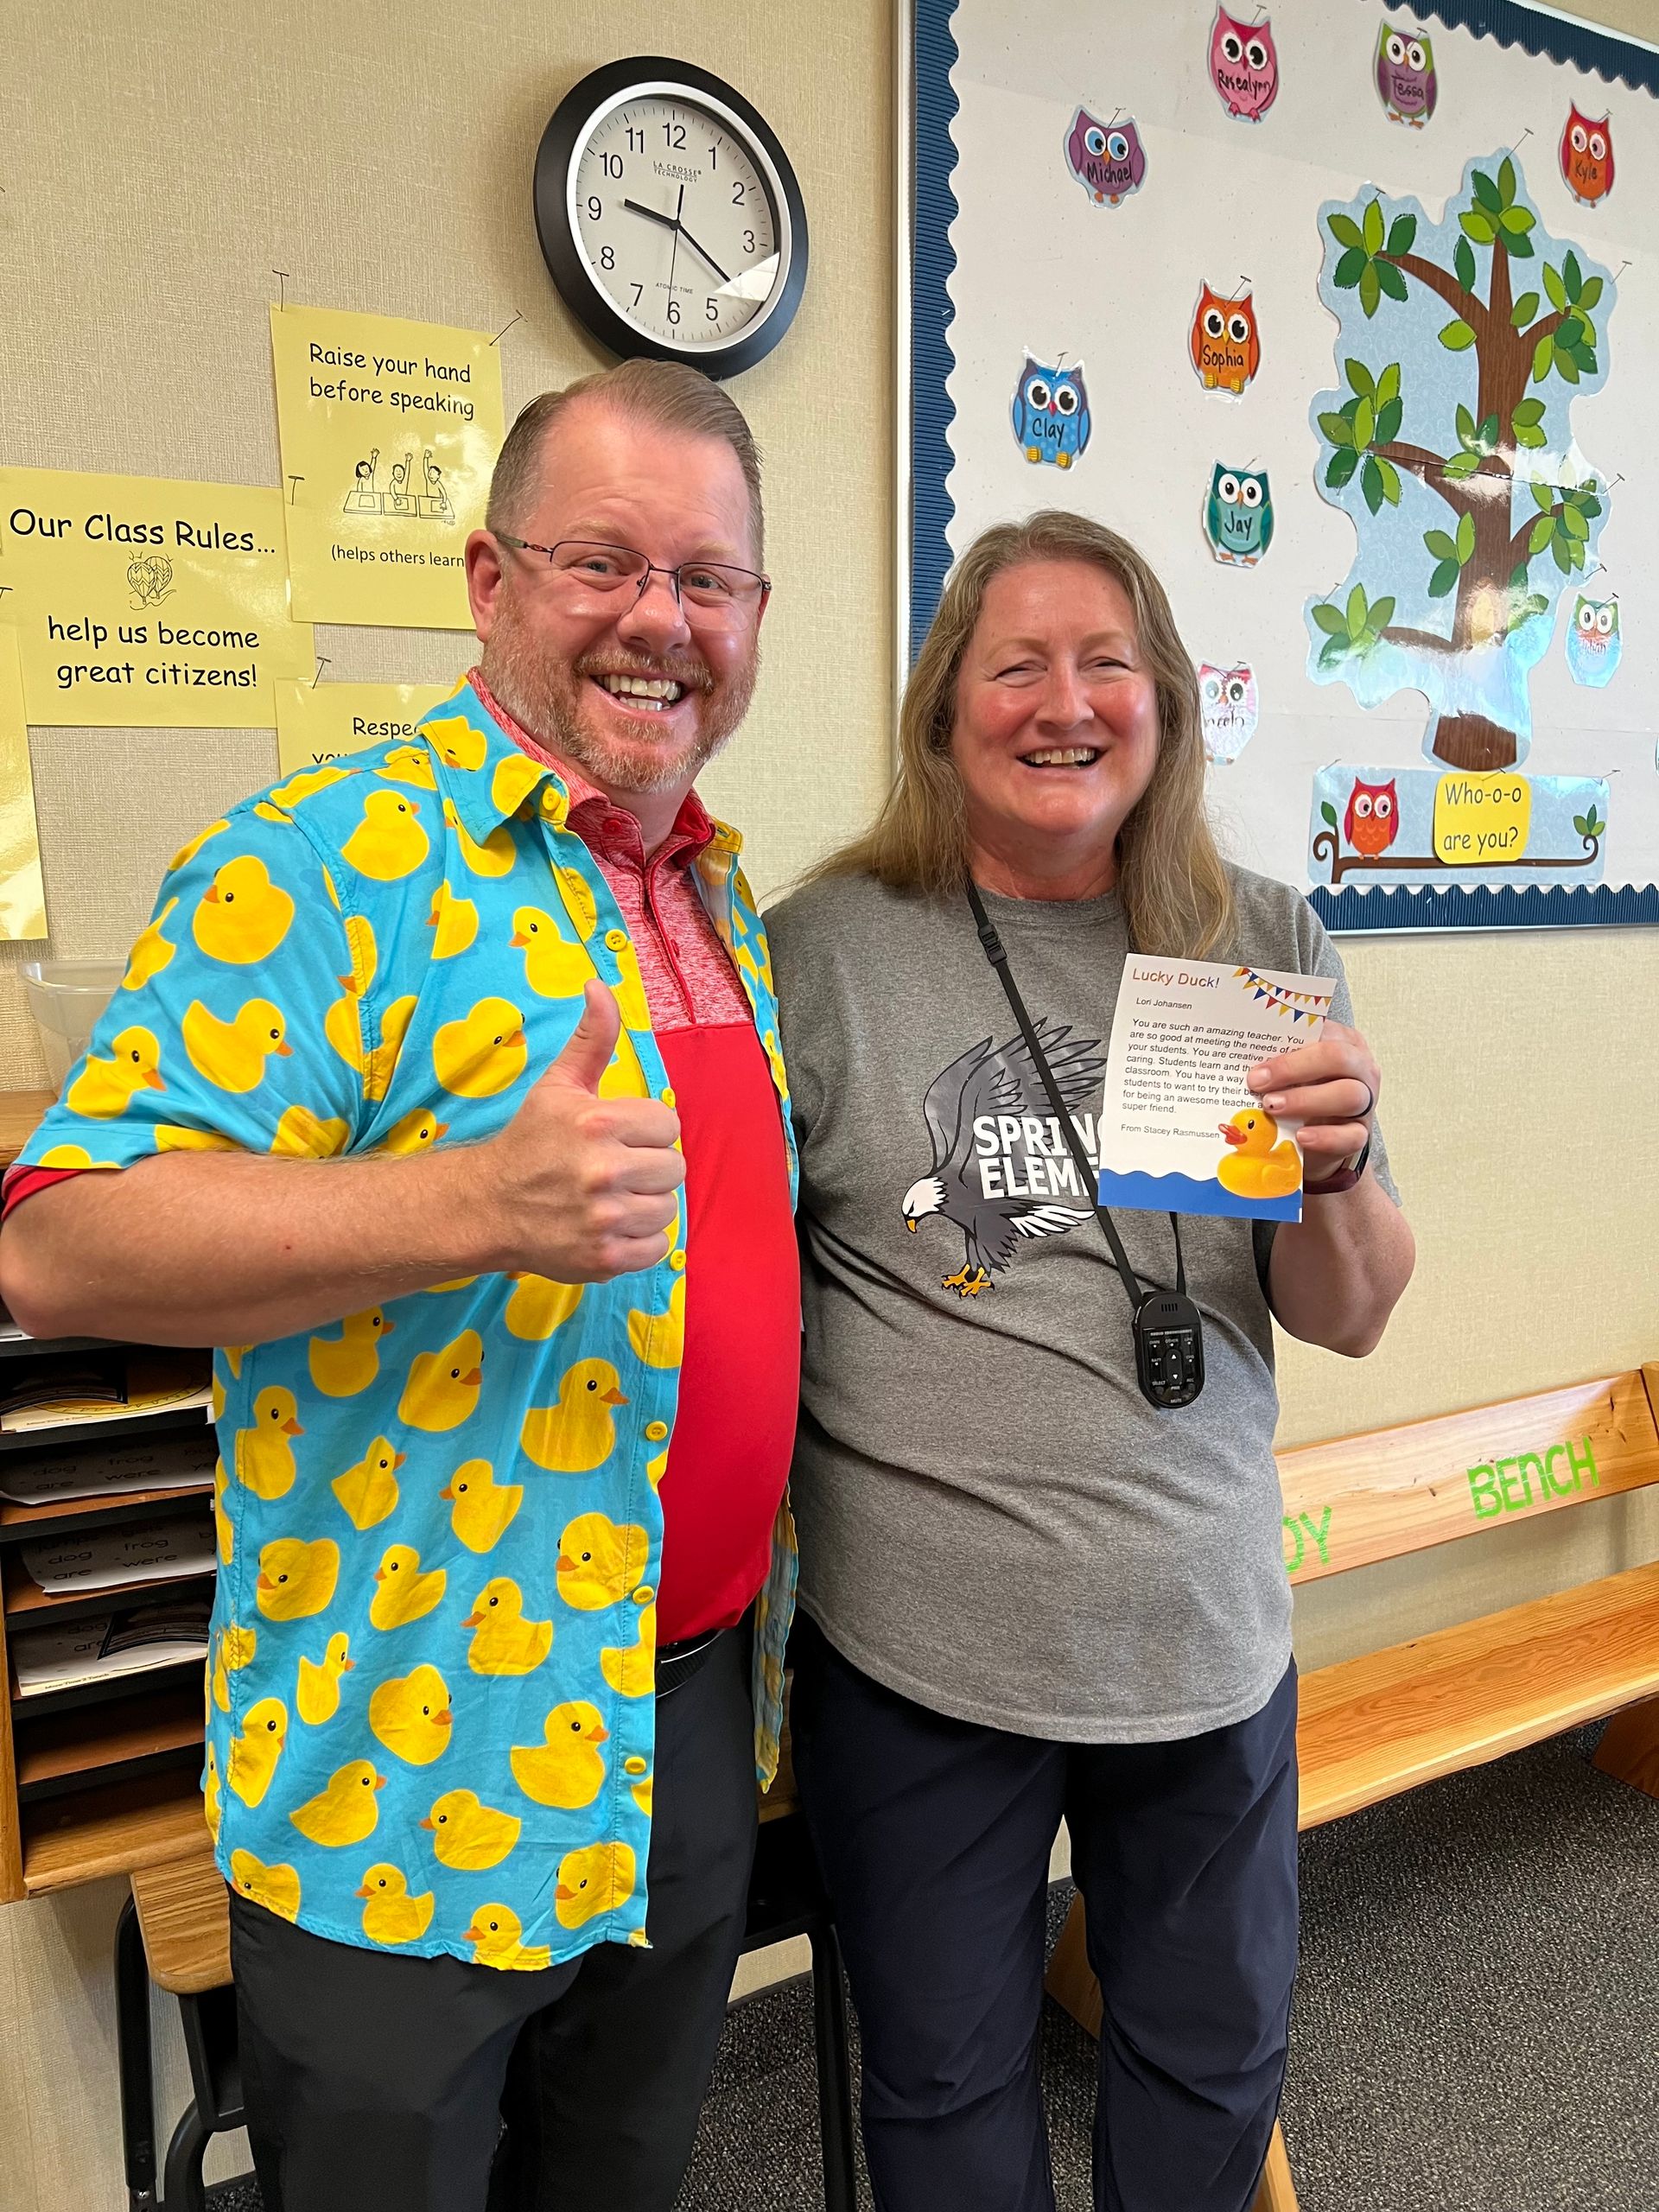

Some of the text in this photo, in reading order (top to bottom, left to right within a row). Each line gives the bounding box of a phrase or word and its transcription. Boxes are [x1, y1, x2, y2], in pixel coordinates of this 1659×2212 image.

[1391, 75, 1424, 102] Tessa
[626, 126, 645, 154] 11
[662, 122, 686, 149] 12
[600, 152, 623, 179] 10
[709, 146, 717, 170] 1
[654, 168, 696, 182] TECHNOLOGY
[1086, 159, 1133, 185] Michael
[1574, 159, 1599, 182] Kyle
[733, 181, 745, 206] 2
[588, 196, 601, 220] 9
[743, 230, 755, 253] 3
[601, 245, 615, 270] 8
[630, 283, 644, 307] 7
[668, 302, 681, 324] 6
[706, 297, 718, 321] 5
[309, 343, 471, 384] Raise your hand
[1202, 343, 1245, 370] Sophia
[309, 377, 474, 422] before speaking
[1033, 417, 1065, 448] Clay
[9, 508, 276, 554] Our Class Rules...
[1224, 510, 1252, 541] Jay
[331, 544, 465, 568] (helps others learn
[48, 615, 260, 650] help us become
[57, 661, 258, 690] great citizens!
[1445, 783, 1522, 805] Who-o-o
[1444, 827, 1518, 860] are you?
[1133, 969, 1219, 988] Lucky Duck!
[1136, 998, 1192, 1010] Lori Johansen
[1133, 1018, 1149, 1027] You
[1206, 1027, 1244, 1039] amazing
[1248, 1032, 1283, 1042] teacher.
[1287, 1035, 1304, 1045] You
[1128, 1043, 1147, 1052] your
[1150, 1045, 1189, 1054] students.
[1193, 1047, 1210, 1056] You
[1229, 1052, 1263, 1062] creative
[1195, 1038, 1230, 1048] meeting
[1249, 1043, 1276, 1052] needs
[1159, 1057, 1197, 1068] Students
[1199, 1060, 1221, 1069] learn
[1123, 1078, 1161, 1088] students
[1209, 1085, 1219, 1095] try
[1223, 1086, 1241, 1095] their
[1175, 1070, 1192, 1078] You
[1195, 1071, 1216, 1080] have
[1227, 1076, 1243, 1084] way
[1122, 1103, 1176, 1113] super friend.
[1123, 1090, 1135, 1098] for
[1137, 1091, 1161, 1102] being
[1177, 1096, 1219, 1105] awesome
[1223, 1099, 1255, 1108] teacher
[973, 1113, 1100, 1156] SPRIN
[1121, 1124, 1220, 1138] From Stacey Rasmussen
[105, 1470, 161, 1480] were
[1467, 1435, 1599, 1519] BENCH
[48, 1539, 168, 1565] dog frog
[54, 1554, 178, 1580] are were
